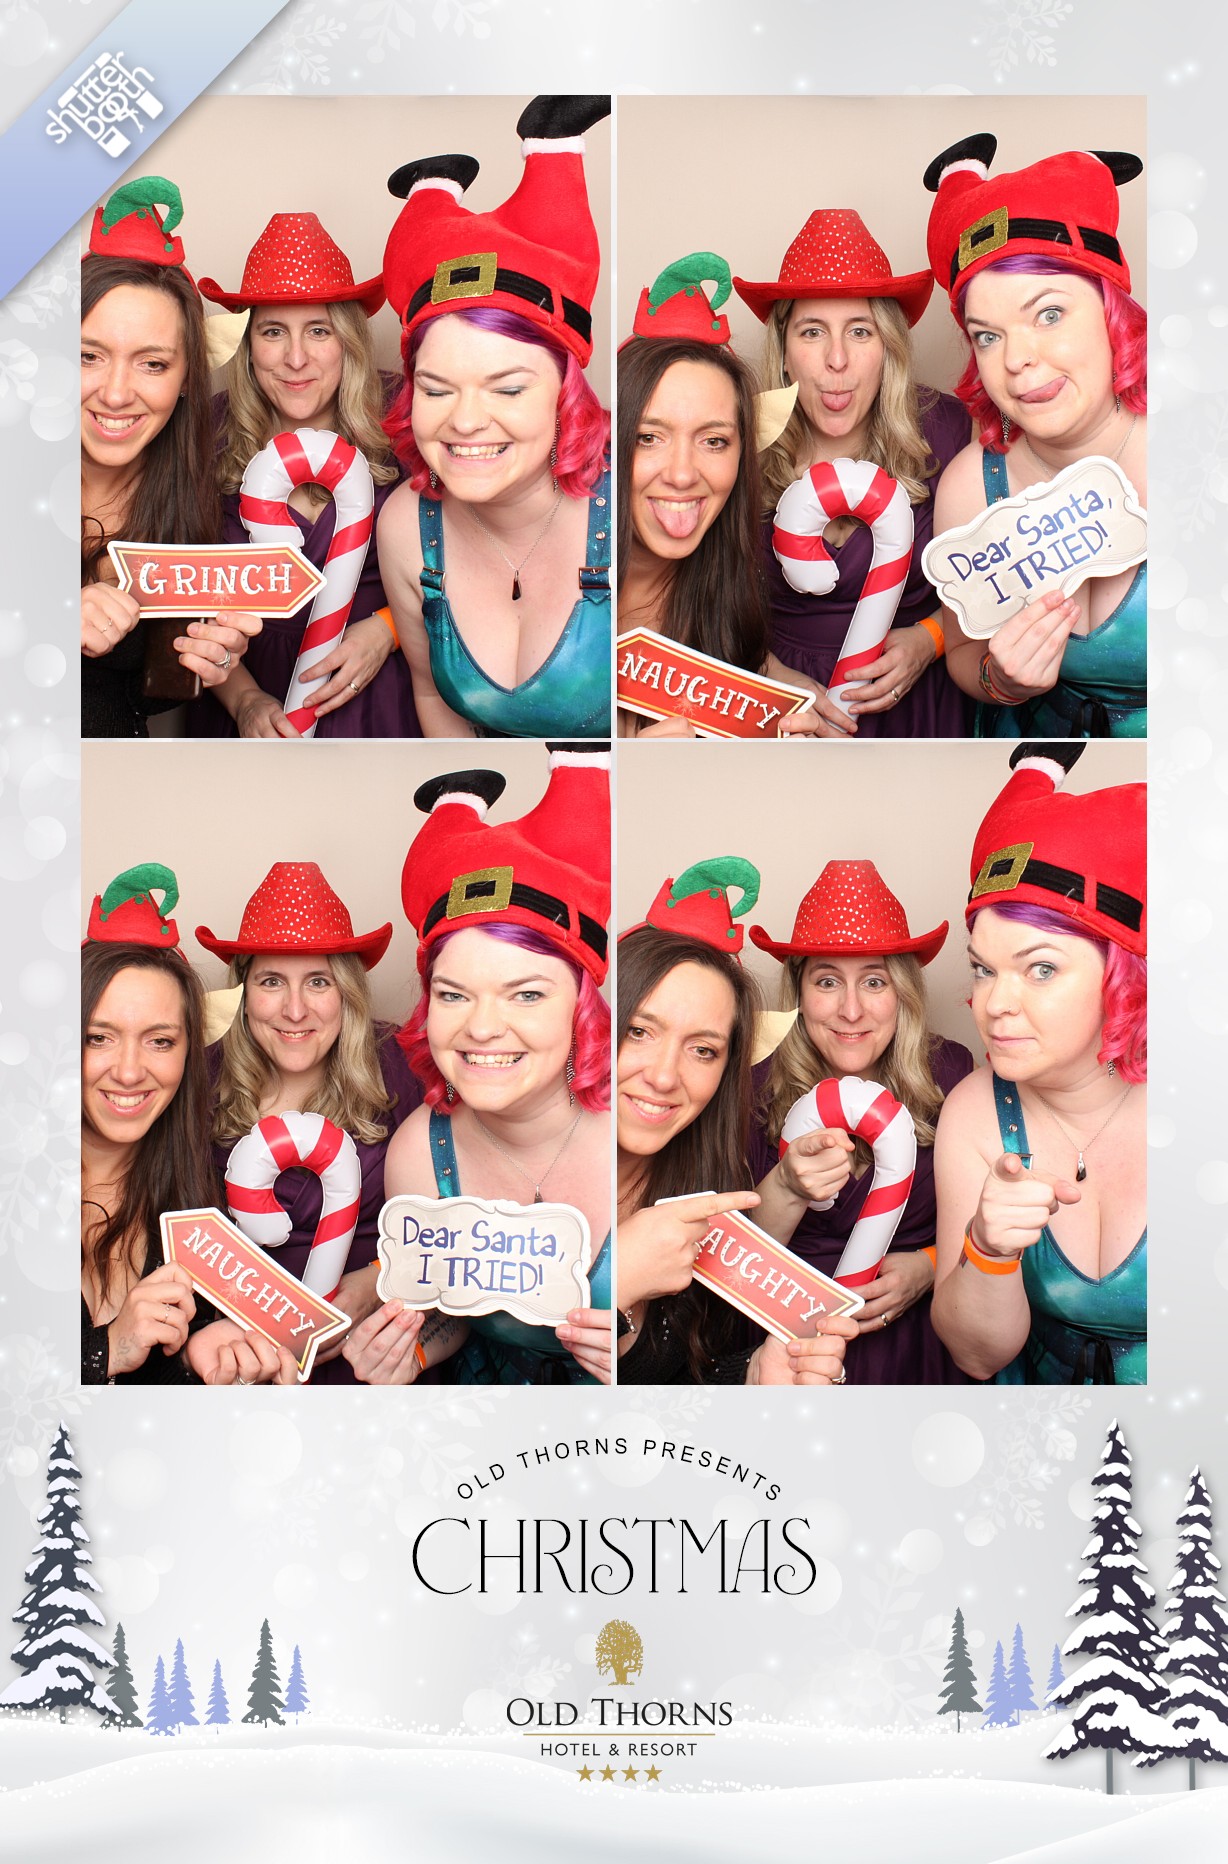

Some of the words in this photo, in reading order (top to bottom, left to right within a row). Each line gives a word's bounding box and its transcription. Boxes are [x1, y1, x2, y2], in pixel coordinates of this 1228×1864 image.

[947, 535, 1012, 582] Dear
[1016, 489, 1113, 546] Santa,
[984, 572, 1011, 605] I
[1008, 520, 1112, 590] TRIED!
[138, 562, 293, 596] GRINCH
[617, 652, 781, 730] NAUGHTY
[402, 1215, 462, 1250] Dear
[471, 1219, 565, 1263] Santa,
[417, 1253, 434, 1285] I
[443, 1256, 544, 1296] TRIED!
[699, 1223, 827, 1322] AUGHTY
[182, 1226, 316, 1337] NAUGHTY
